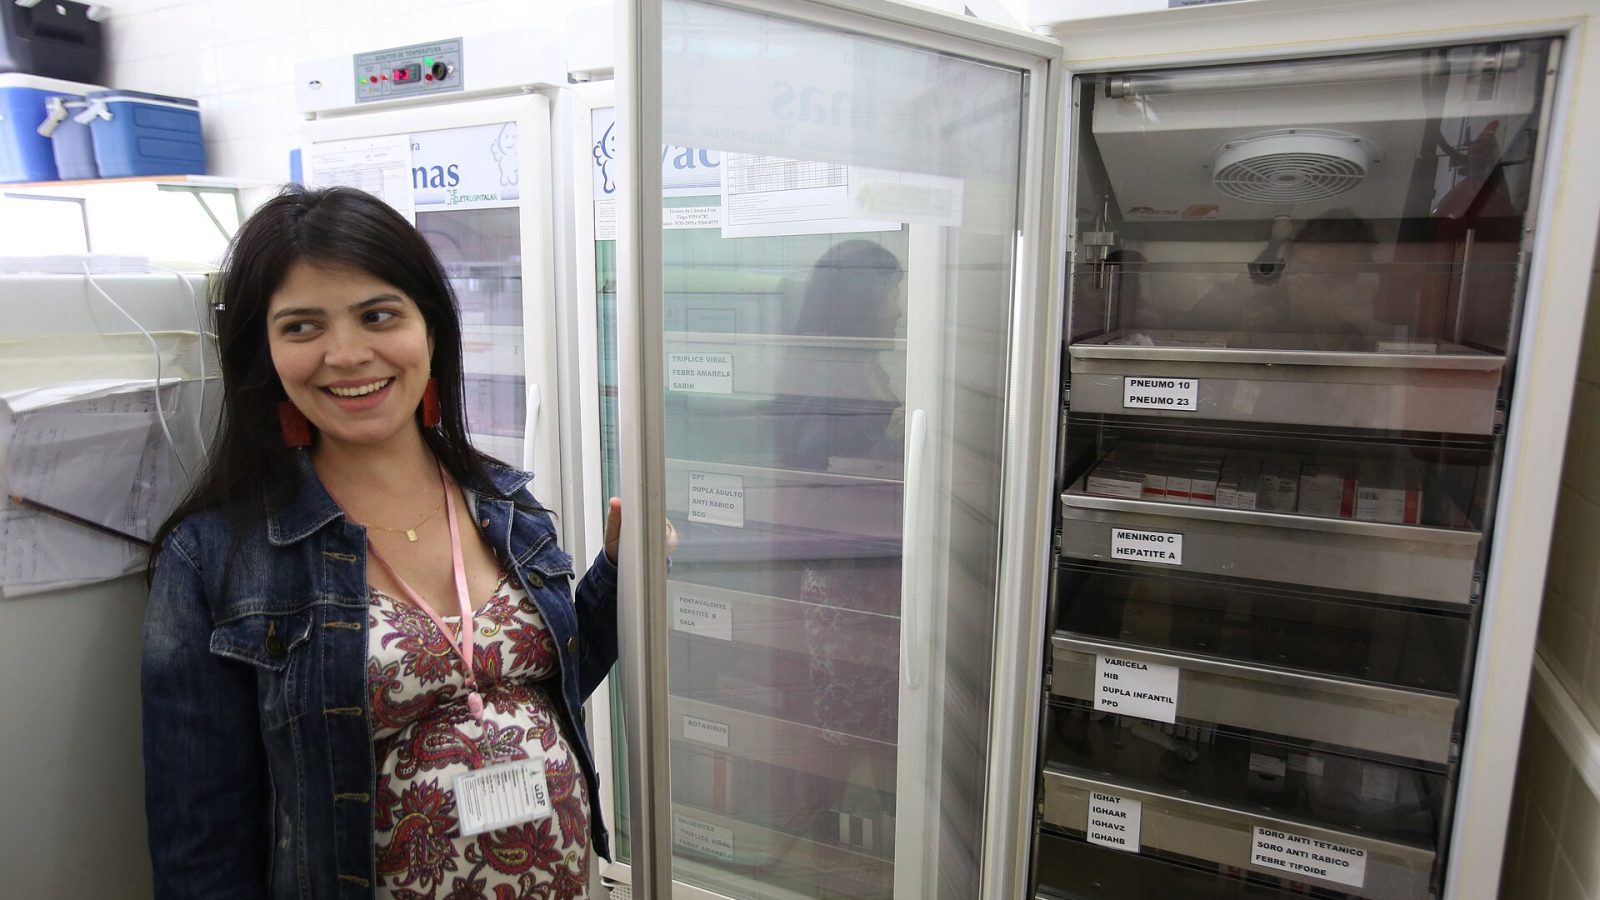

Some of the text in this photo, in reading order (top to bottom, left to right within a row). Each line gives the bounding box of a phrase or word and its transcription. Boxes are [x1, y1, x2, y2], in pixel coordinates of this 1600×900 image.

[705, 356, 728, 364] VIRAL
[672, 369, 731, 378] FEBRE AMARELA
[672, 382, 695, 390] SABIN
[1130, 379, 1190, 390] PNEUMO 10
[1129, 396, 1189, 406] PNEUMO 23
[692, 486, 743, 498] DUPLA ADULTO
[692, 498, 735, 510] ANTI RABICO
[692, 510, 706, 518] BCG
[1116, 532, 1174, 544] MENINGO C
[1116, 547, 1176, 560] HEPATITE A
[1104, 658, 1148, 671] VARICELA
[1103, 672, 1119, 680] HIB
[1102, 686, 1174, 704] DUPLA INFANTIL
[1101, 699, 1118, 708] PPD
[688, 720, 727, 734] ROTAVIRUS
[1093, 793, 1121, 804] IGHAT
[1092, 806, 1127, 818] IGHAAR
[1092, 820, 1126, 832] IGHAVZ
[1090, 832, 1126, 844] IGHAHB
[1258, 828, 1364, 857] SORO ANTI TETANICO
[1257, 841, 1349, 868] SORO ANTI RABICO
[1255, 854, 1326, 876] FEBRE TIFOIDE
